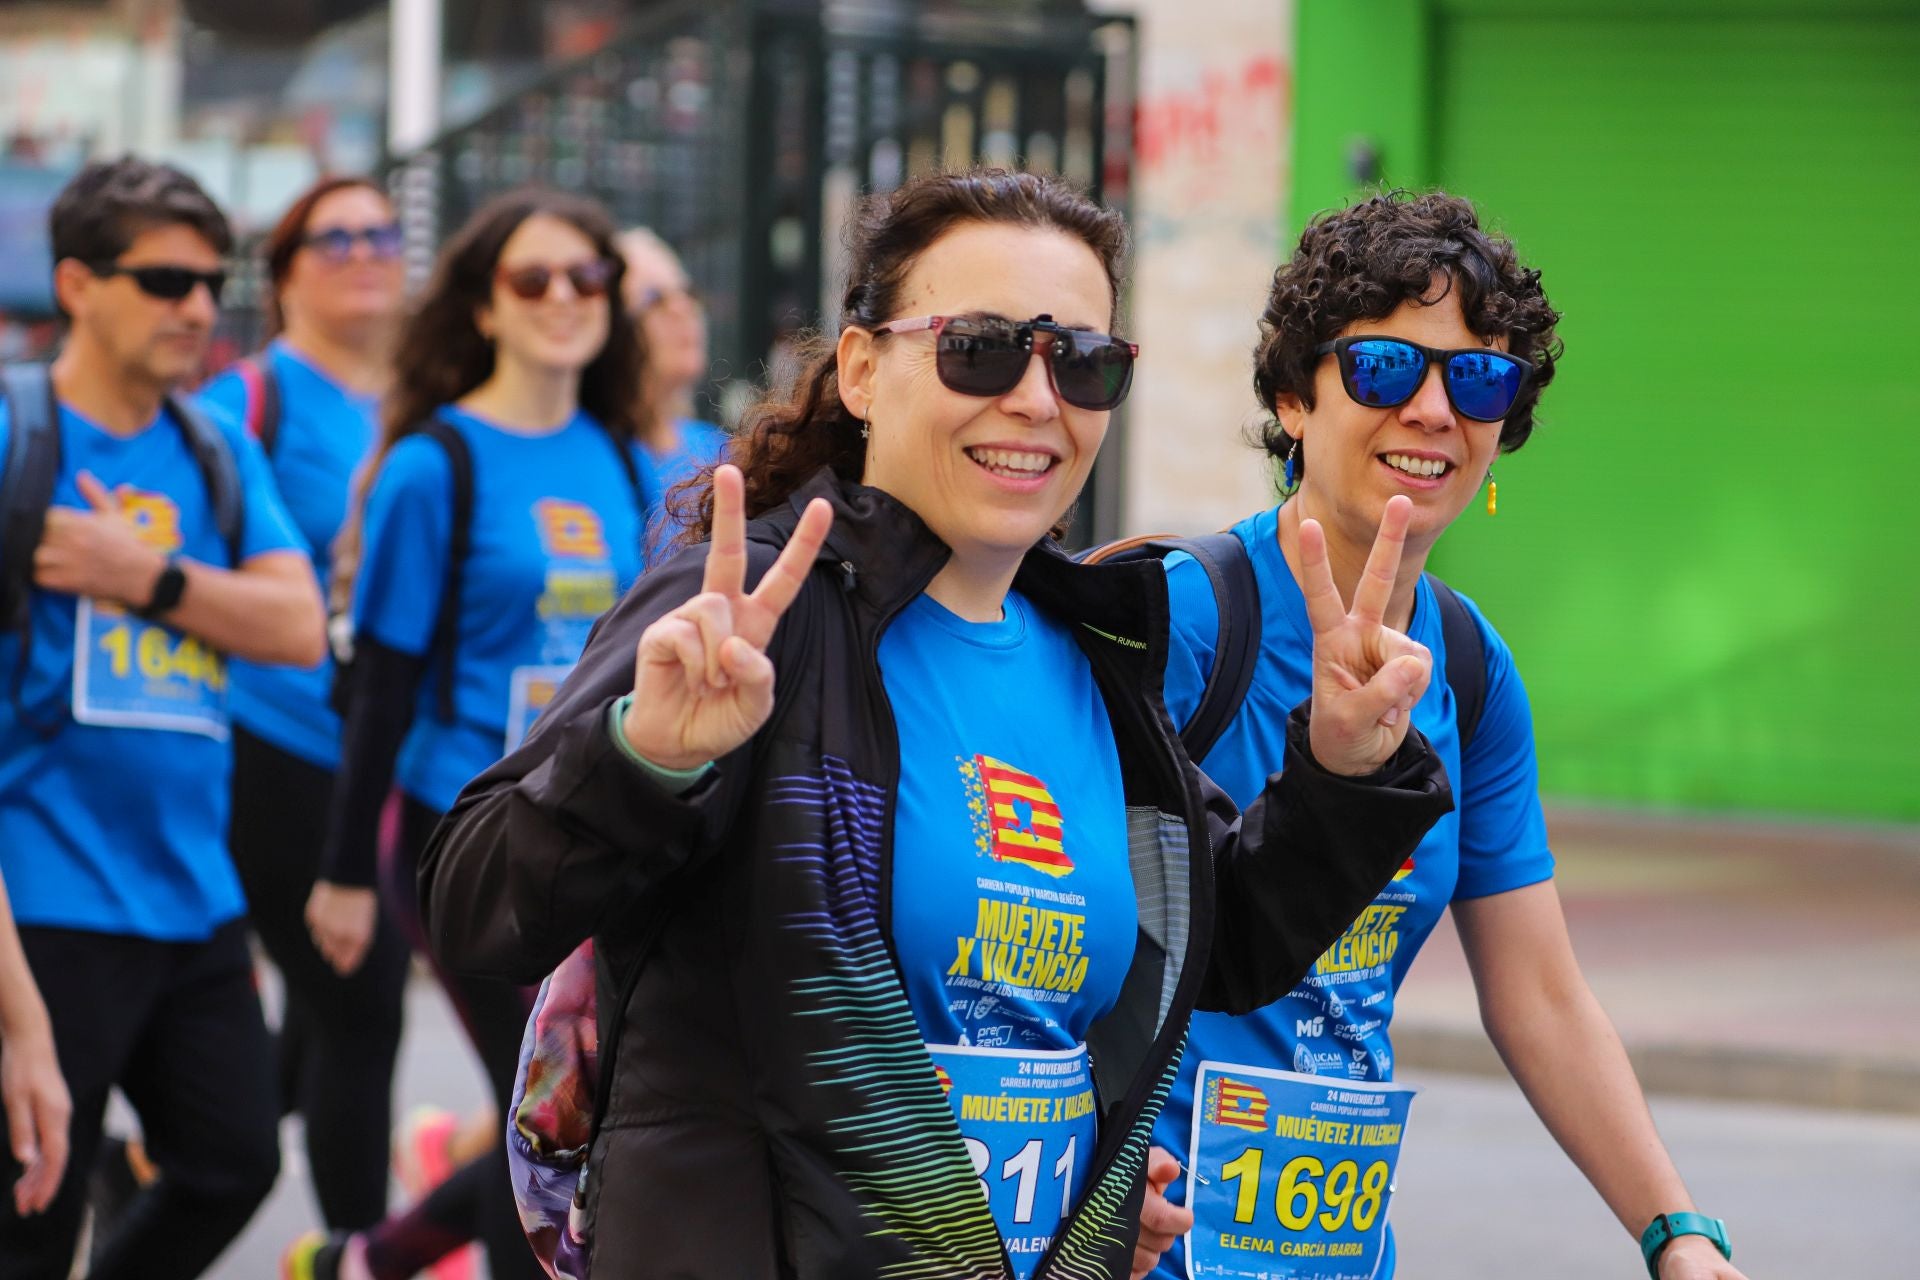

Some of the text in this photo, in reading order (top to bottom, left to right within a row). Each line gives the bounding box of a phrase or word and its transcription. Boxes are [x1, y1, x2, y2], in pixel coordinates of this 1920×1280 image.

[975, 897, 1086, 955] MUÉVETE
[1342, 905, 1407, 937] VETE
[947, 936, 1090, 993] X VALENCIA
[1018, 1062, 1031, 1075] 24
[1032, 1062, 1073, 1075] NOVIEMBRE
[1313, 1052, 1342, 1063] UCAM
[1000, 1077, 1031, 1088] CARRERA
[1327, 1090, 1339, 1102] 24
[960, 1091, 1052, 1123] MUÉVETE
[1051, 1097, 1064, 1122] X
[1275, 1114, 1402, 1147] MUÉVETE X VALENCIA
[1220, 1147, 1390, 1233] 1698
[1003, 1236, 1056, 1253] VALEN
[1219, 1233, 1364, 1257] ELENA GARCÍA IBARRA
